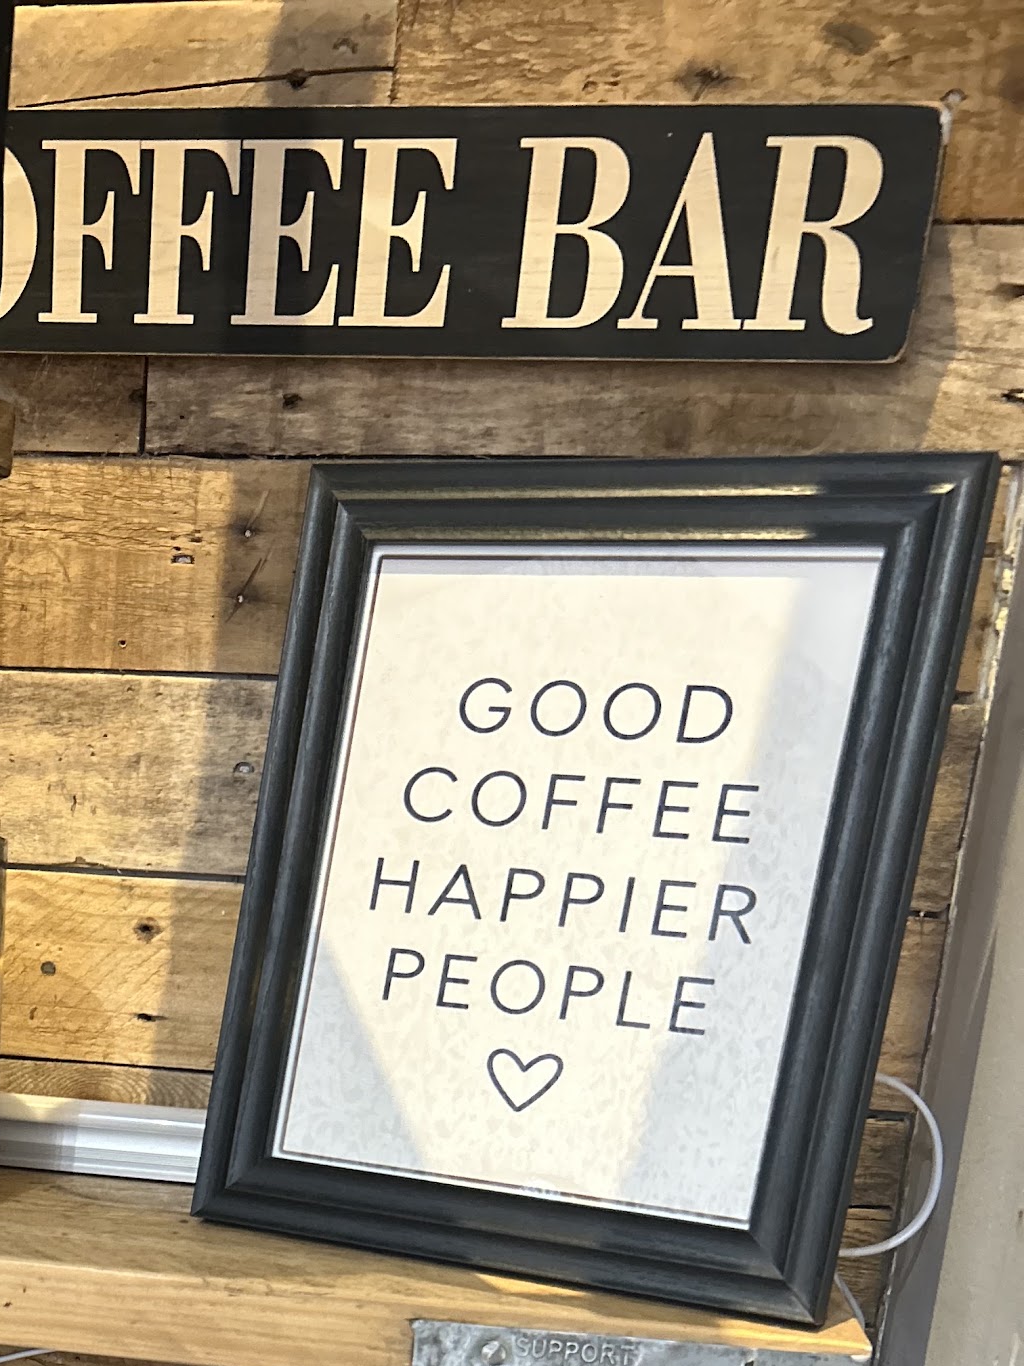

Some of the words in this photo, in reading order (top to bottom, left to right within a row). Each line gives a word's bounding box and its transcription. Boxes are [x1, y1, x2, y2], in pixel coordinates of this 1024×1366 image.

[501, 131, 885, 336] BAR
[459, 677, 733, 744] GOOD
[404, 766, 759, 844] COFFEE
[369, 857, 757, 945] HAPPIER
[382, 947, 715, 1036] PEOPLE
[514, 1335, 636, 1366] SUPPORT
